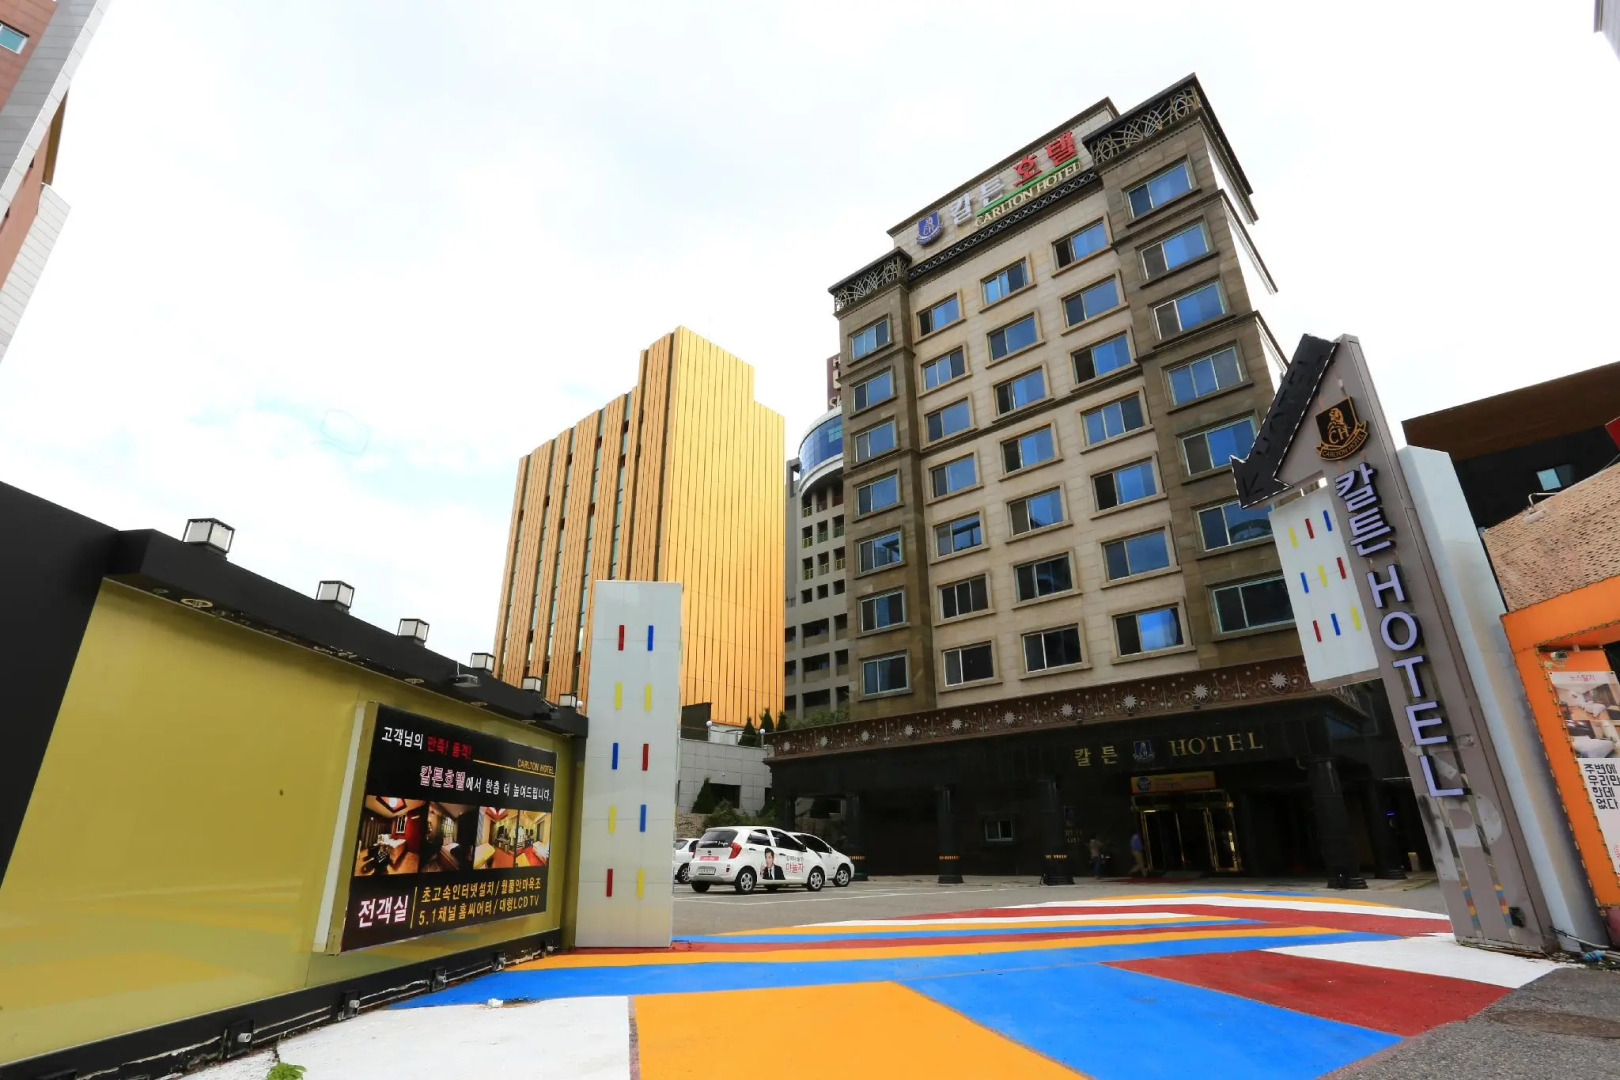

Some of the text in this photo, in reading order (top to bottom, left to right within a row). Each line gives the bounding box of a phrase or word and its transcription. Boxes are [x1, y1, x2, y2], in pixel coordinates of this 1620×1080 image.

[974, 162, 1082, 228] CARLTON HOTEL
[1322, 432, 1365, 458] CARLTON HOTEL
[1328, 427, 1349, 444] CH
[1334, 462, 1466, 798] 칼튼 HOTEL
[382, 726, 423, 750] 고객님의
[427, 736, 449, 755] 만족!
[1168, 731, 1264, 757] HOTEL
[516, 758, 555, 775] CARLTON HOTEL
[1583, 763, 1618, 775] 주변에
[485, 779, 500, 795] 한층
[503, 782, 511, 797] 더
[1588, 775, 1620, 786] 우리만
[1596, 798, 1619, 810] 없다
[358, 895, 409, 928] 전객실
